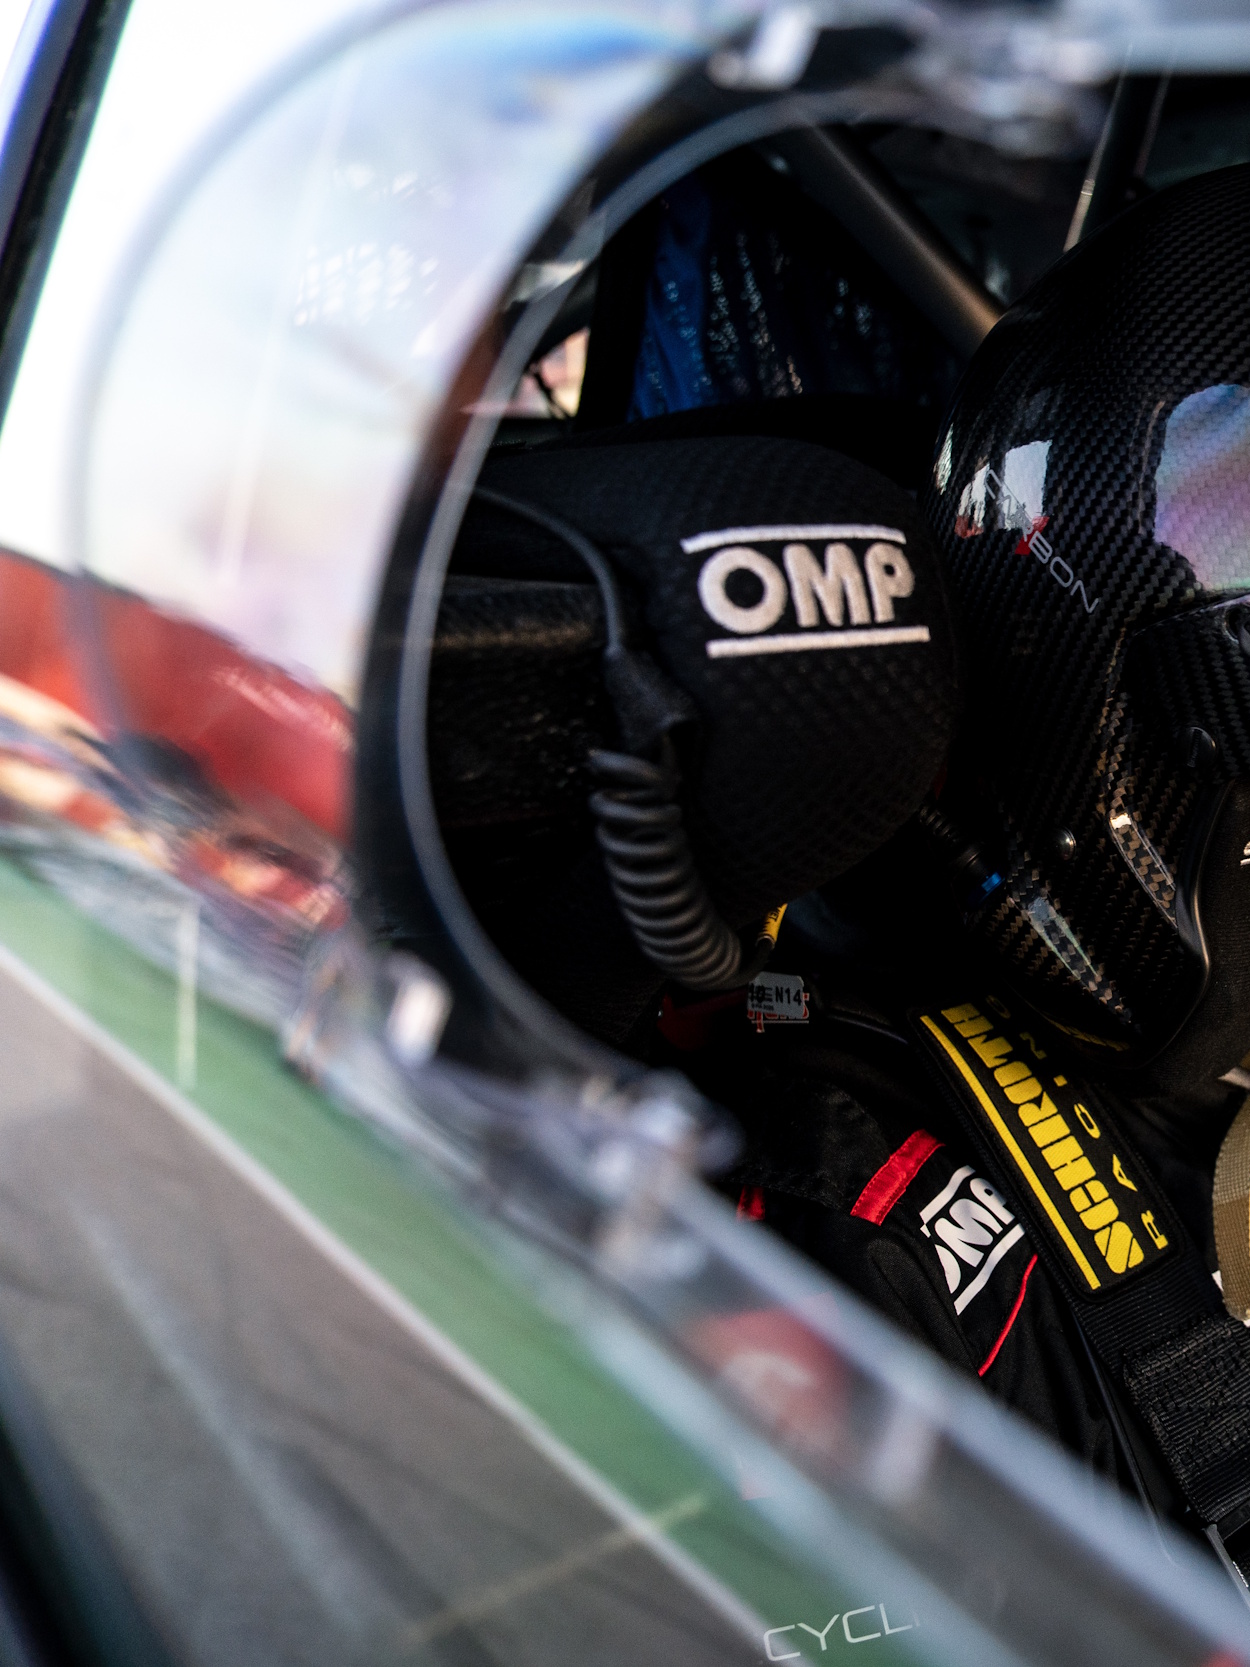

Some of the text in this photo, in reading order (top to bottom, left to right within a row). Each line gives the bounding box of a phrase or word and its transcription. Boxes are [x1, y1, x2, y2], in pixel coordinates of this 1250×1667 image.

[696, 543, 914, 634] OMP
[940, 1001, 1145, 1275] SCHROTH
[763, 1602, 922, 1662] CYCL
